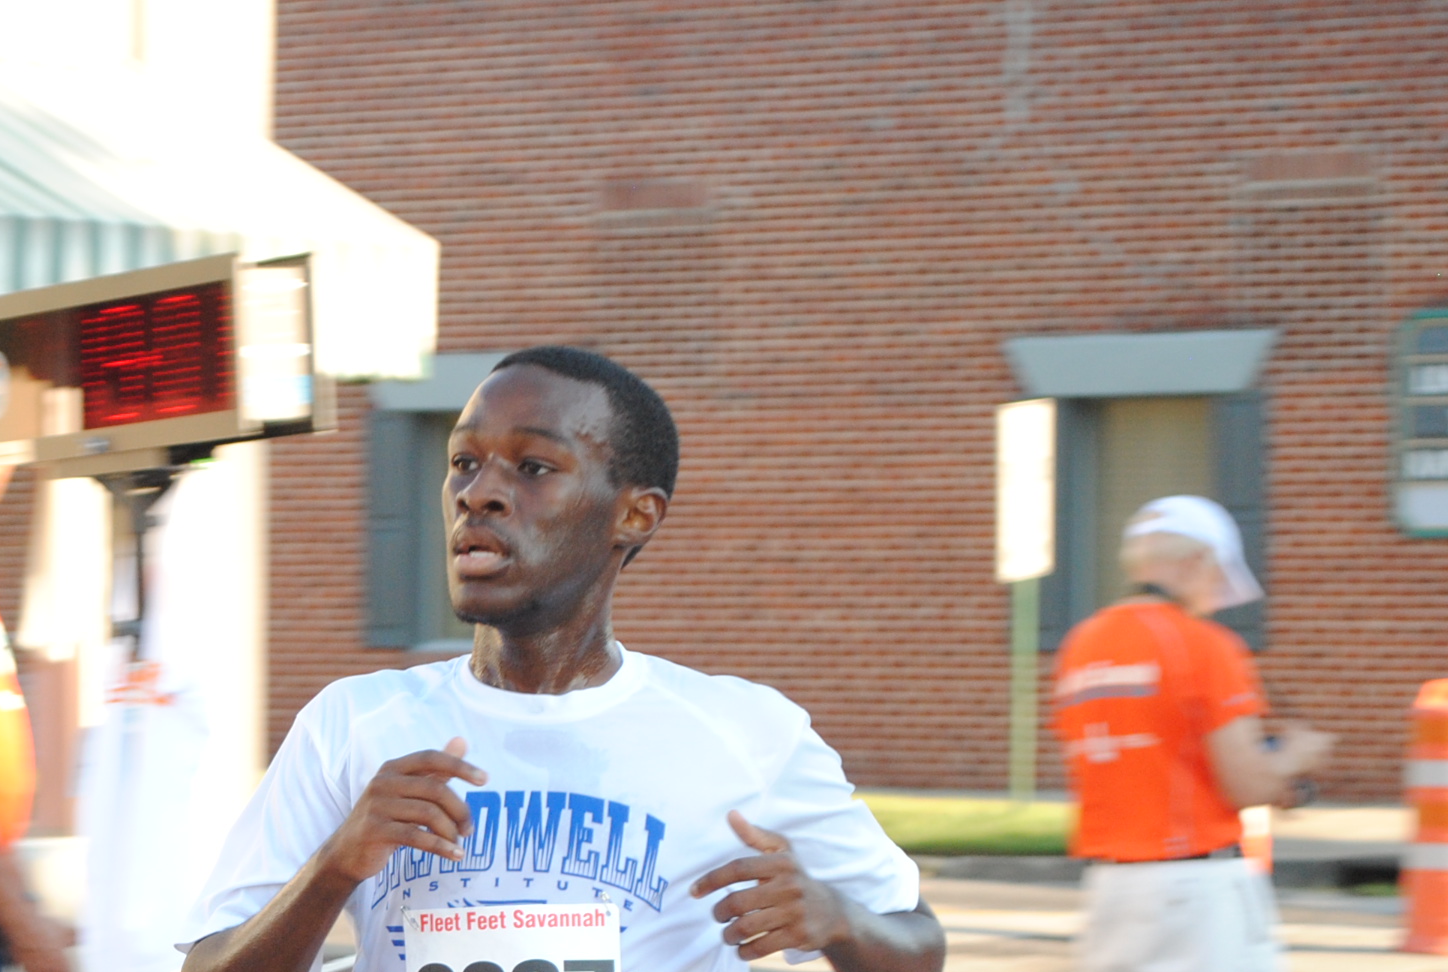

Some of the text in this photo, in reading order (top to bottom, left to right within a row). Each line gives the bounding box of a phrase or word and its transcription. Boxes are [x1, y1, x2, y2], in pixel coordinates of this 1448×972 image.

[371, 791, 669, 912] DWELL
[386, 877, 633, 912] NSTITUTE
[420, 908, 606, 933] Fleet Feet Savannah
